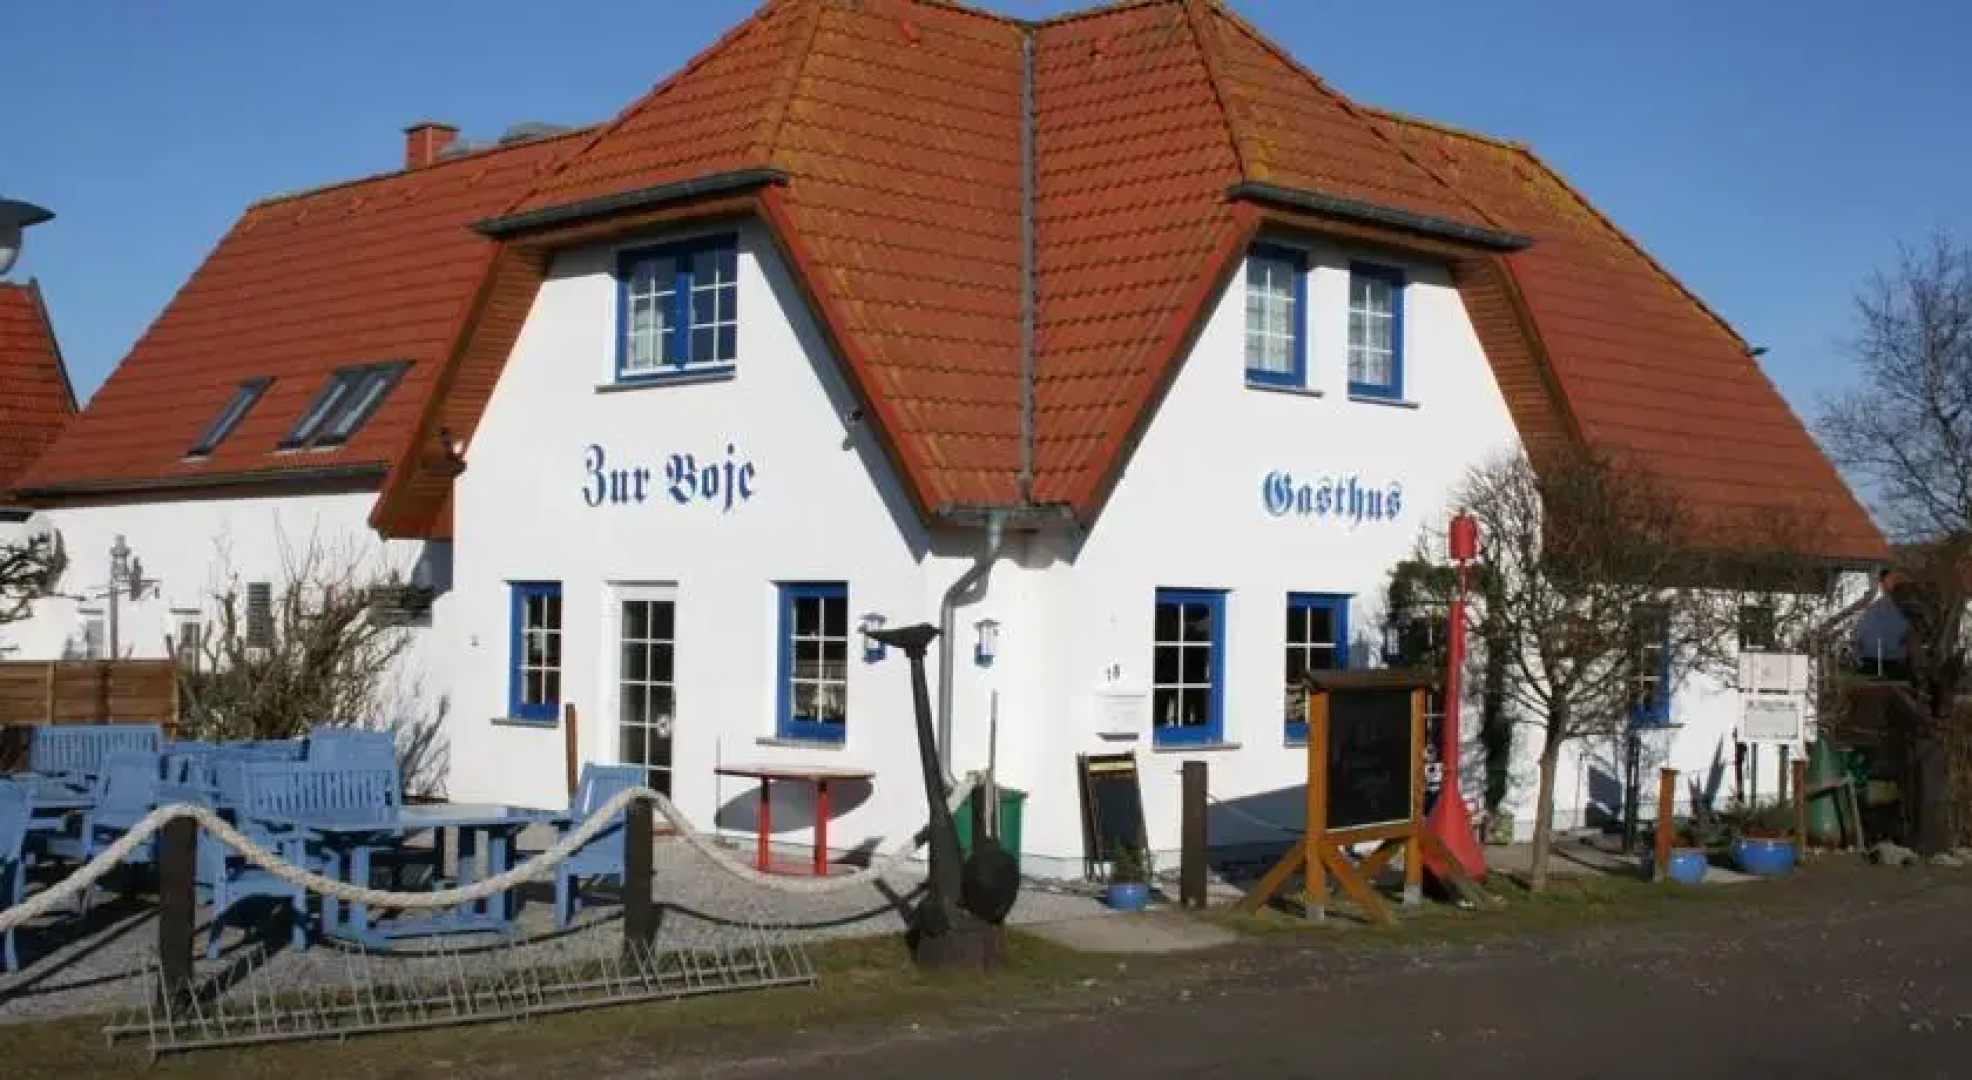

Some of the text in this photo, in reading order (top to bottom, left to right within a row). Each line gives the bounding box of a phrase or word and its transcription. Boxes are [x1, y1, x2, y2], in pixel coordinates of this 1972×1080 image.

[582, 443, 756, 514] Zur Boje
[1263, 470, 1402, 526] Gasthus
